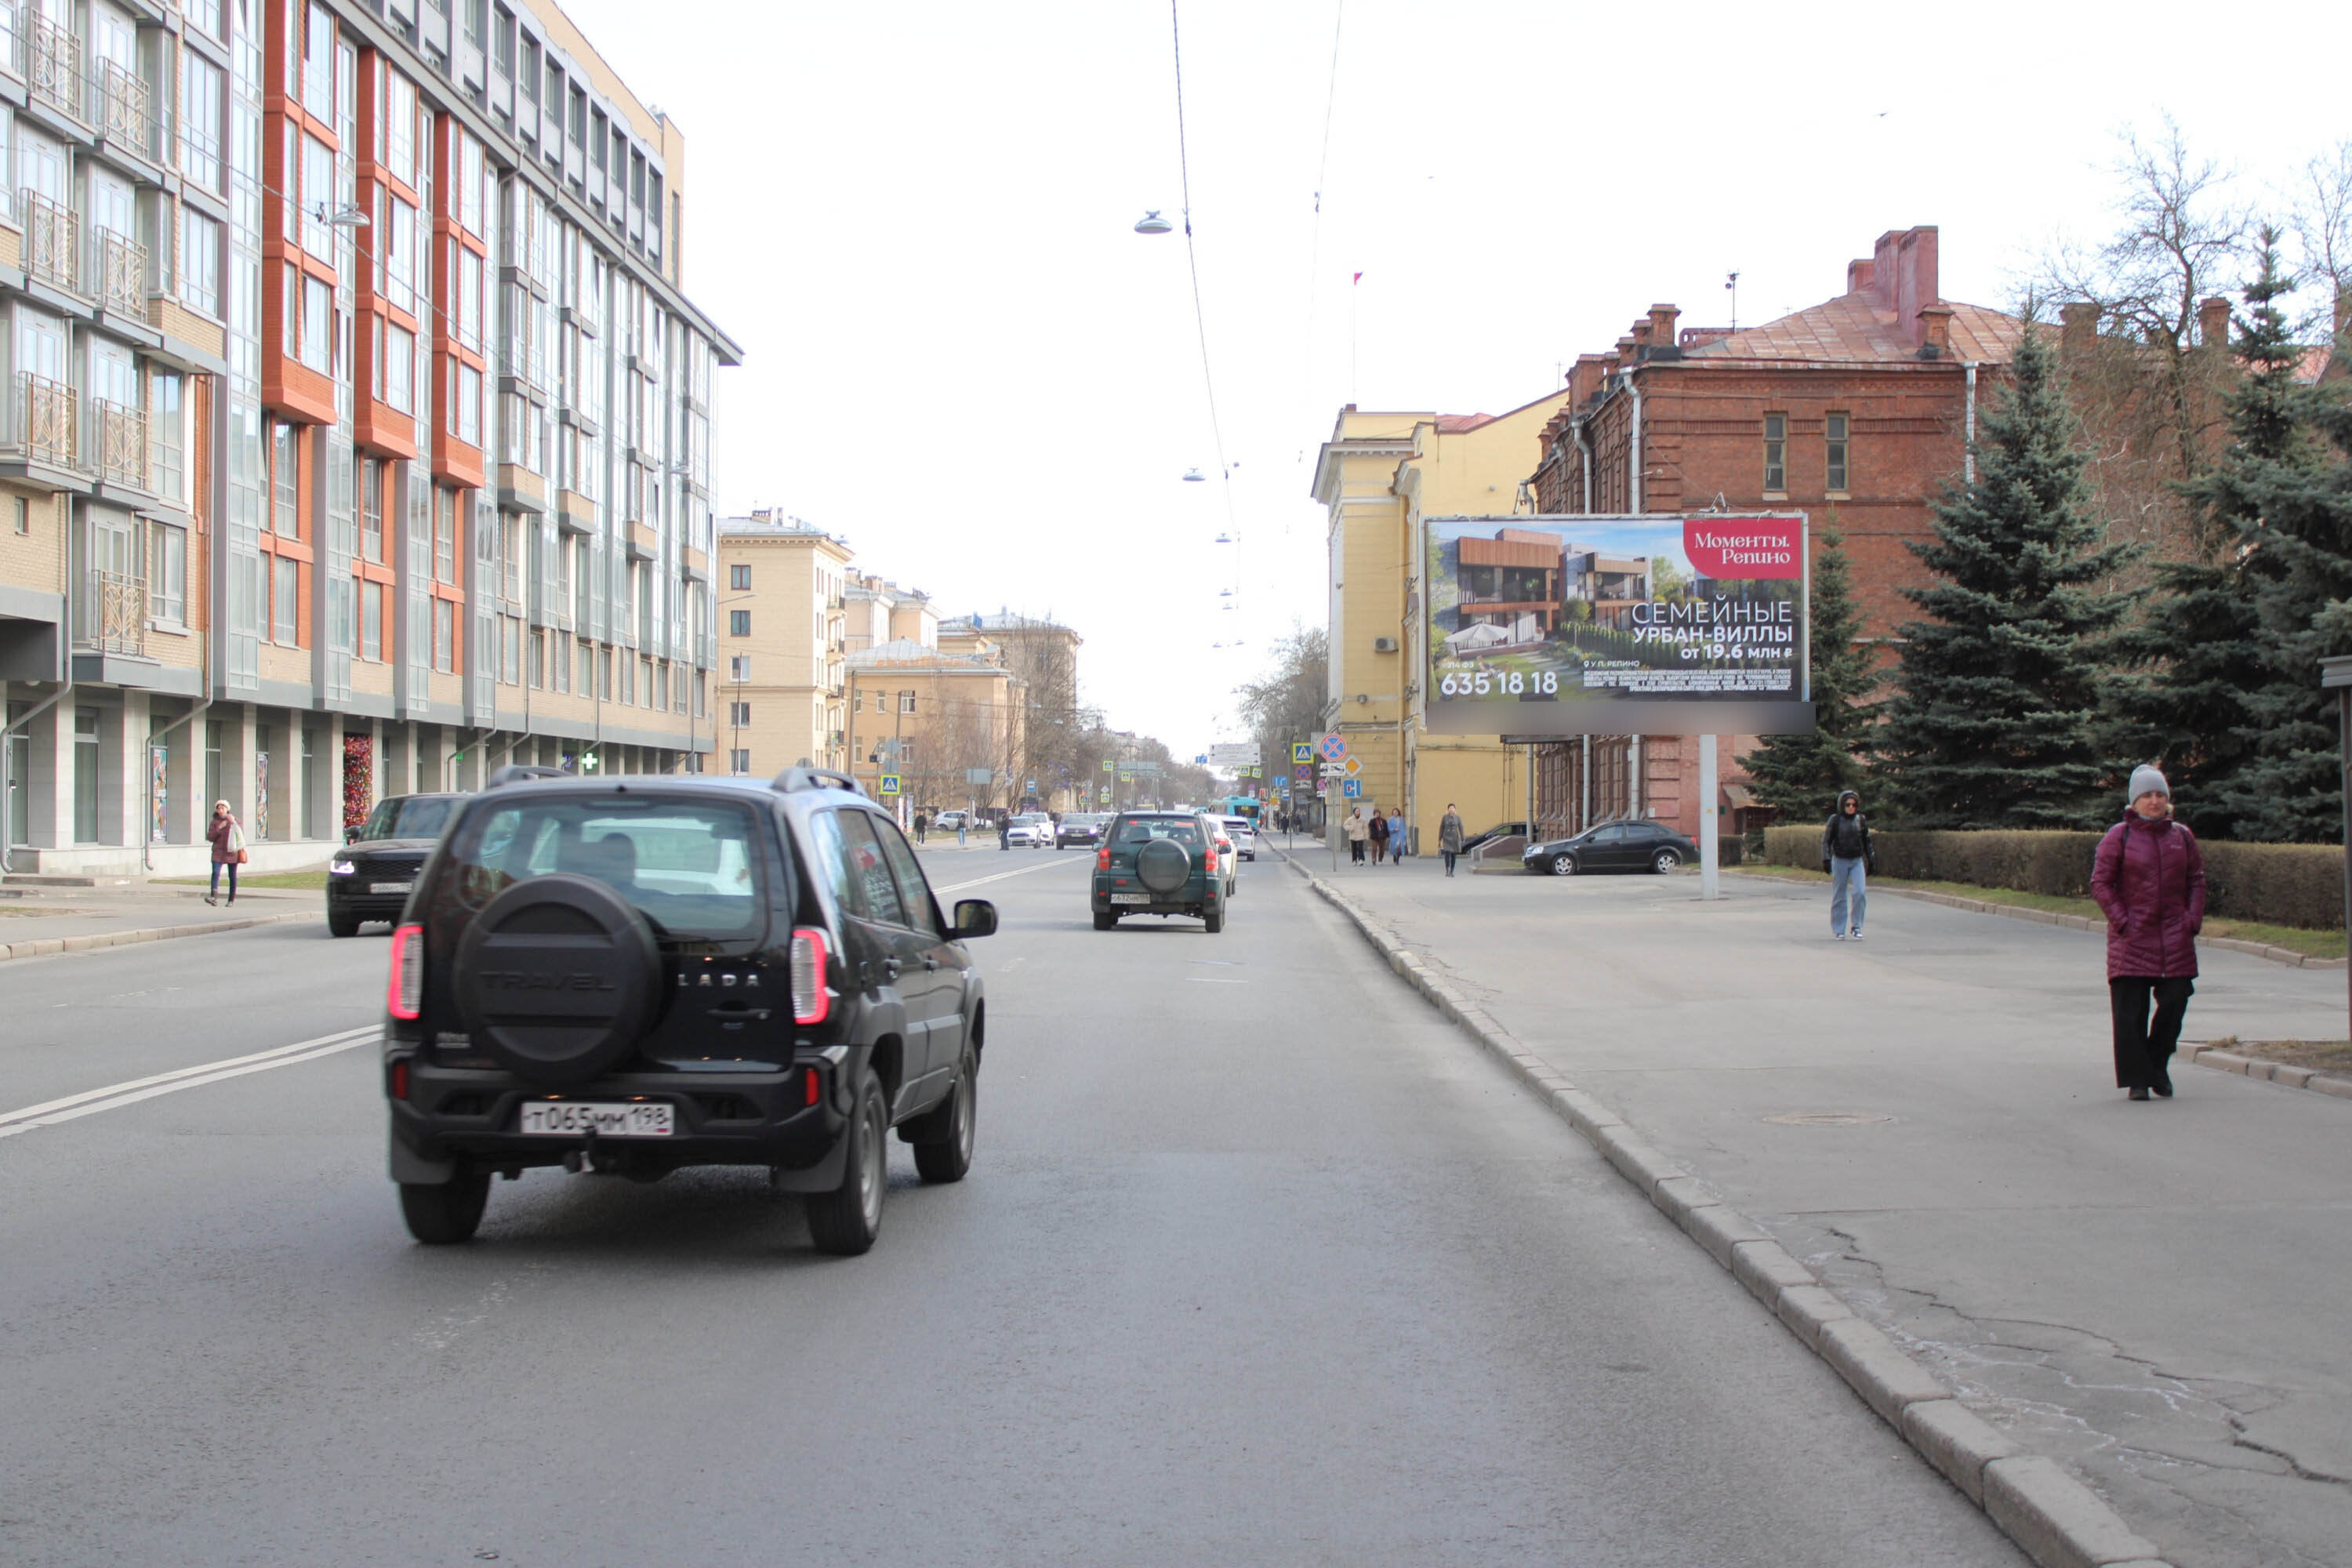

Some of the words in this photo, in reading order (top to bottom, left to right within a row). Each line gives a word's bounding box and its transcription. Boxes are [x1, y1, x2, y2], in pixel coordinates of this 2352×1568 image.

[1695, 532, 1790, 548] Моменты.
[1722, 548, 1791, 564] Репино
[1632, 594, 1792, 624] СЕМЕЙНЫЕ
[1633, 626, 1793, 643] УРБАН-ВИЛЛЫ
[1704, 643, 1743, 659] 19.6
[1441, 672, 1490, 695] 635
[1497, 671, 1524, 695] 18
[1531, 671, 1559, 695] 18
[478, 971, 616, 991] TRAVEL
[678, 974, 760, 986] LADA
